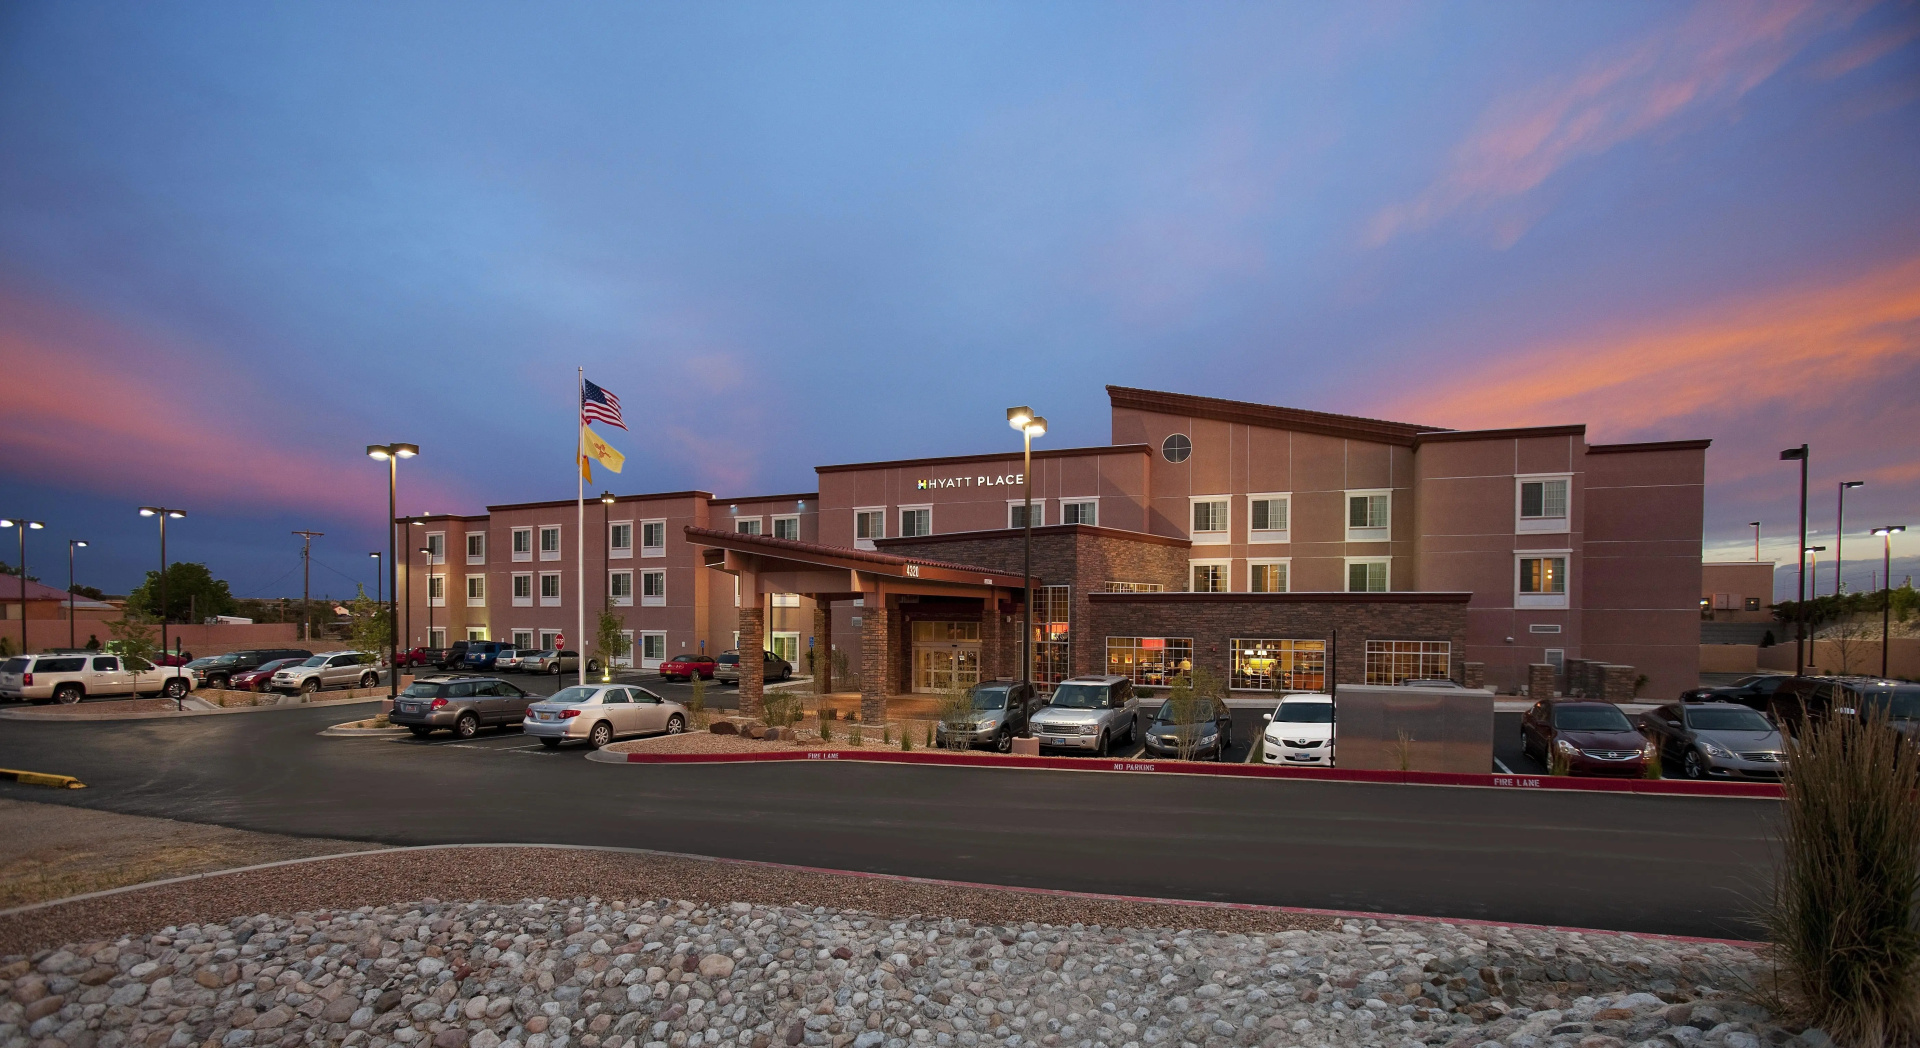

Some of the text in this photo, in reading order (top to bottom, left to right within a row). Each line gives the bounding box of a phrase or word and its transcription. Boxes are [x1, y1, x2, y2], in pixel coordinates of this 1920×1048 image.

[928, 474, 1024, 489] HYATT PLACE
[1494, 778, 1540, 787] FIRE LANE
